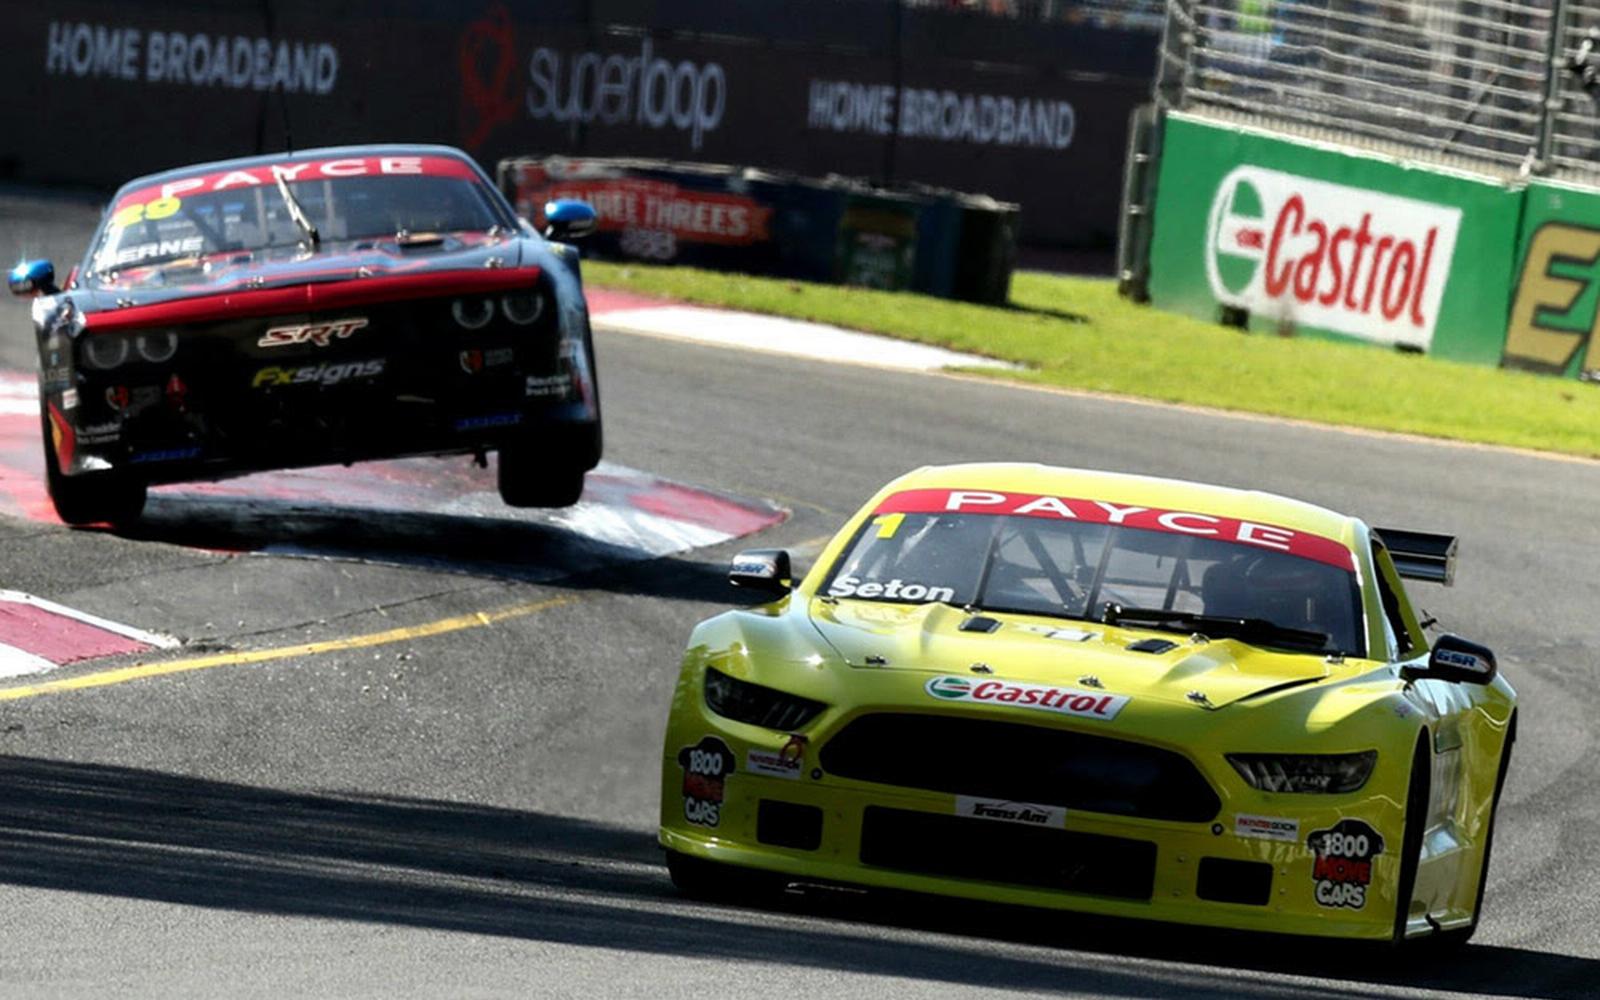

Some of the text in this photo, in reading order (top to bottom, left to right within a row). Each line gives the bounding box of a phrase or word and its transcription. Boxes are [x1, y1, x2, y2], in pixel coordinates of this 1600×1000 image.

[46, 22, 339, 96] HOME BROADBAND
[526, 37, 727, 149] superloop
[807, 79, 1076, 150] HOME BROADBAND
[160, 156, 423, 201] PAYCE
[645, 194, 750, 238] THREES
[1264, 192, 1438, 328] Castrol
[257, 318, 369, 347] SRT
[872, 512, 906, 539] 1
[946, 491, 1295, 551] PAYCE
[827, 576, 955, 602] Seton
[971, 681, 1113, 716] Castrol
[688, 749, 723, 776] 1800
[684, 796, 720, 825] CARS
[1322, 832, 1369, 858] 1800
[1316, 880, 1365, 907] CARS
